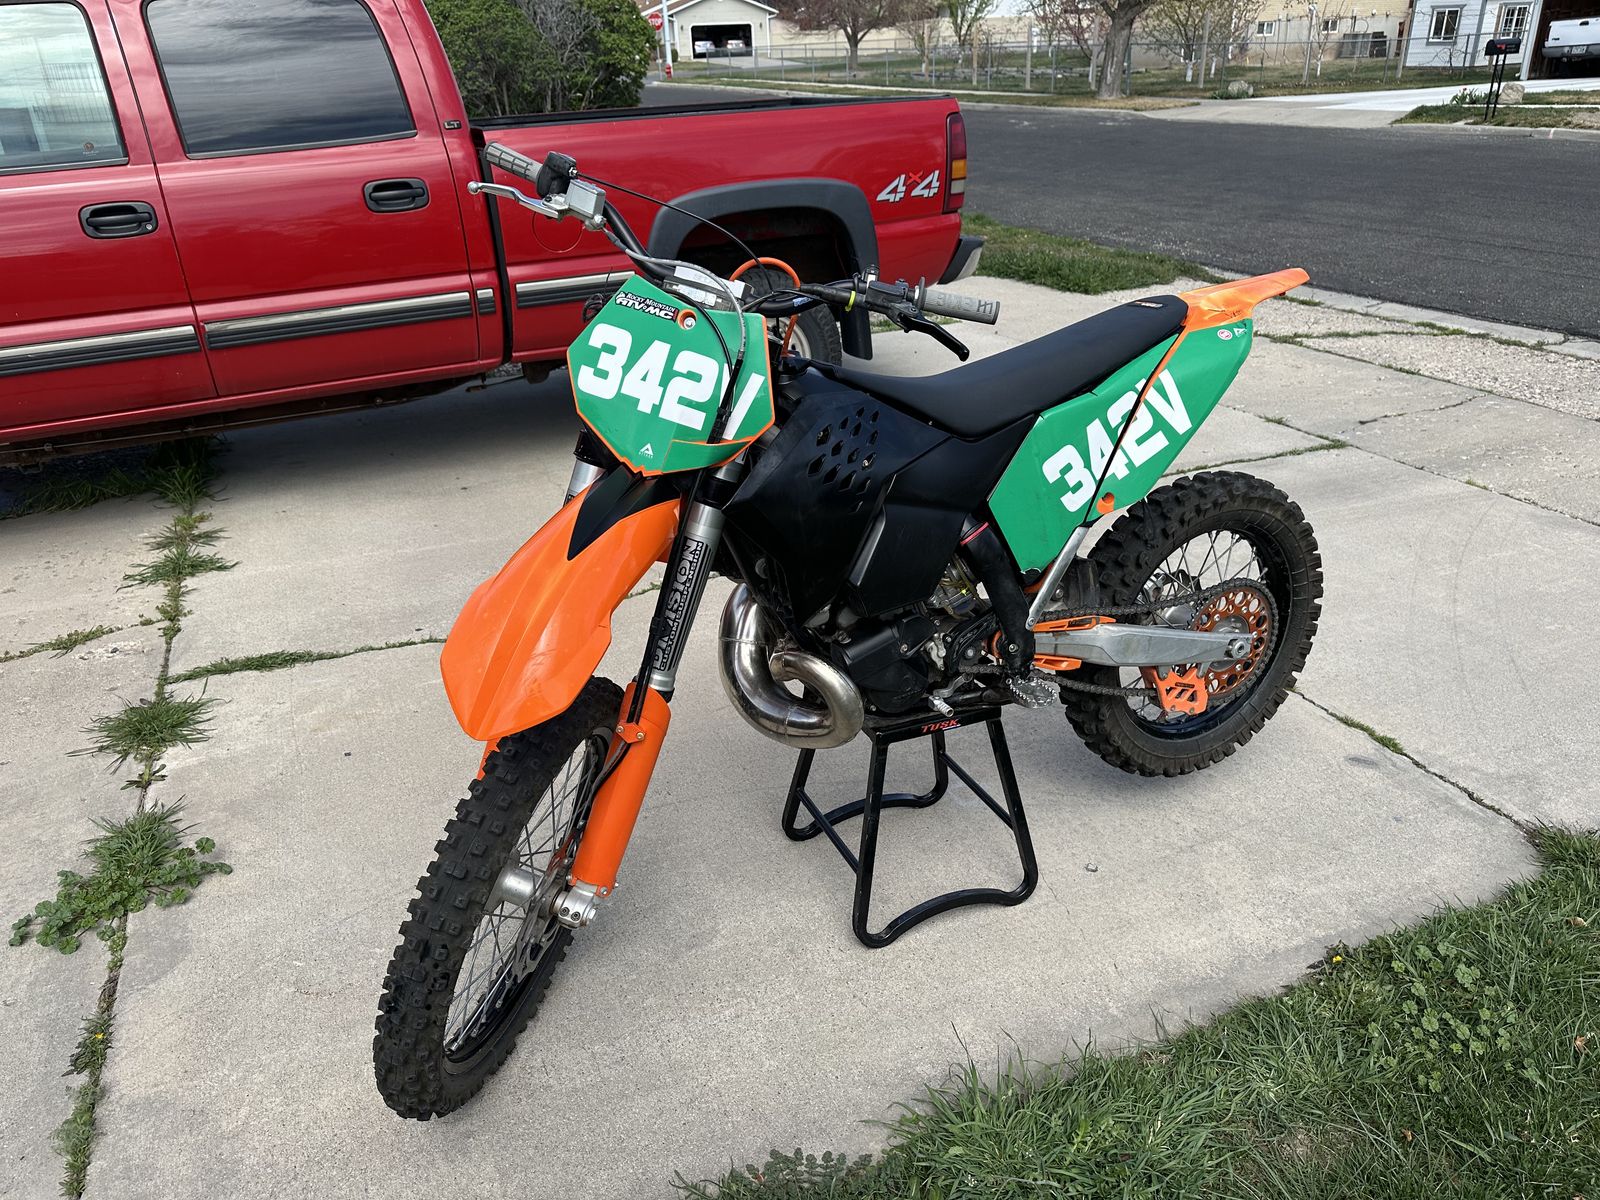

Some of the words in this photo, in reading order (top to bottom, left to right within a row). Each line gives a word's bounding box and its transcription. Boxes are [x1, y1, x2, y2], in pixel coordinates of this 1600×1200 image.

[444, 121, 460, 129] LT
[626, 293, 645, 303] ROCKY
[645, 299, 675, 312] MOUNTAIN
[577, 323, 765, 440] 342V
[1042, 368, 1192, 513] 342V
[651, 538, 698, 669] DIVISION
[659, 621, 678, 670] CUSTOM
[675, 541, 703, 619] SUSPENSION
[922, 719, 959, 733] TUSK
